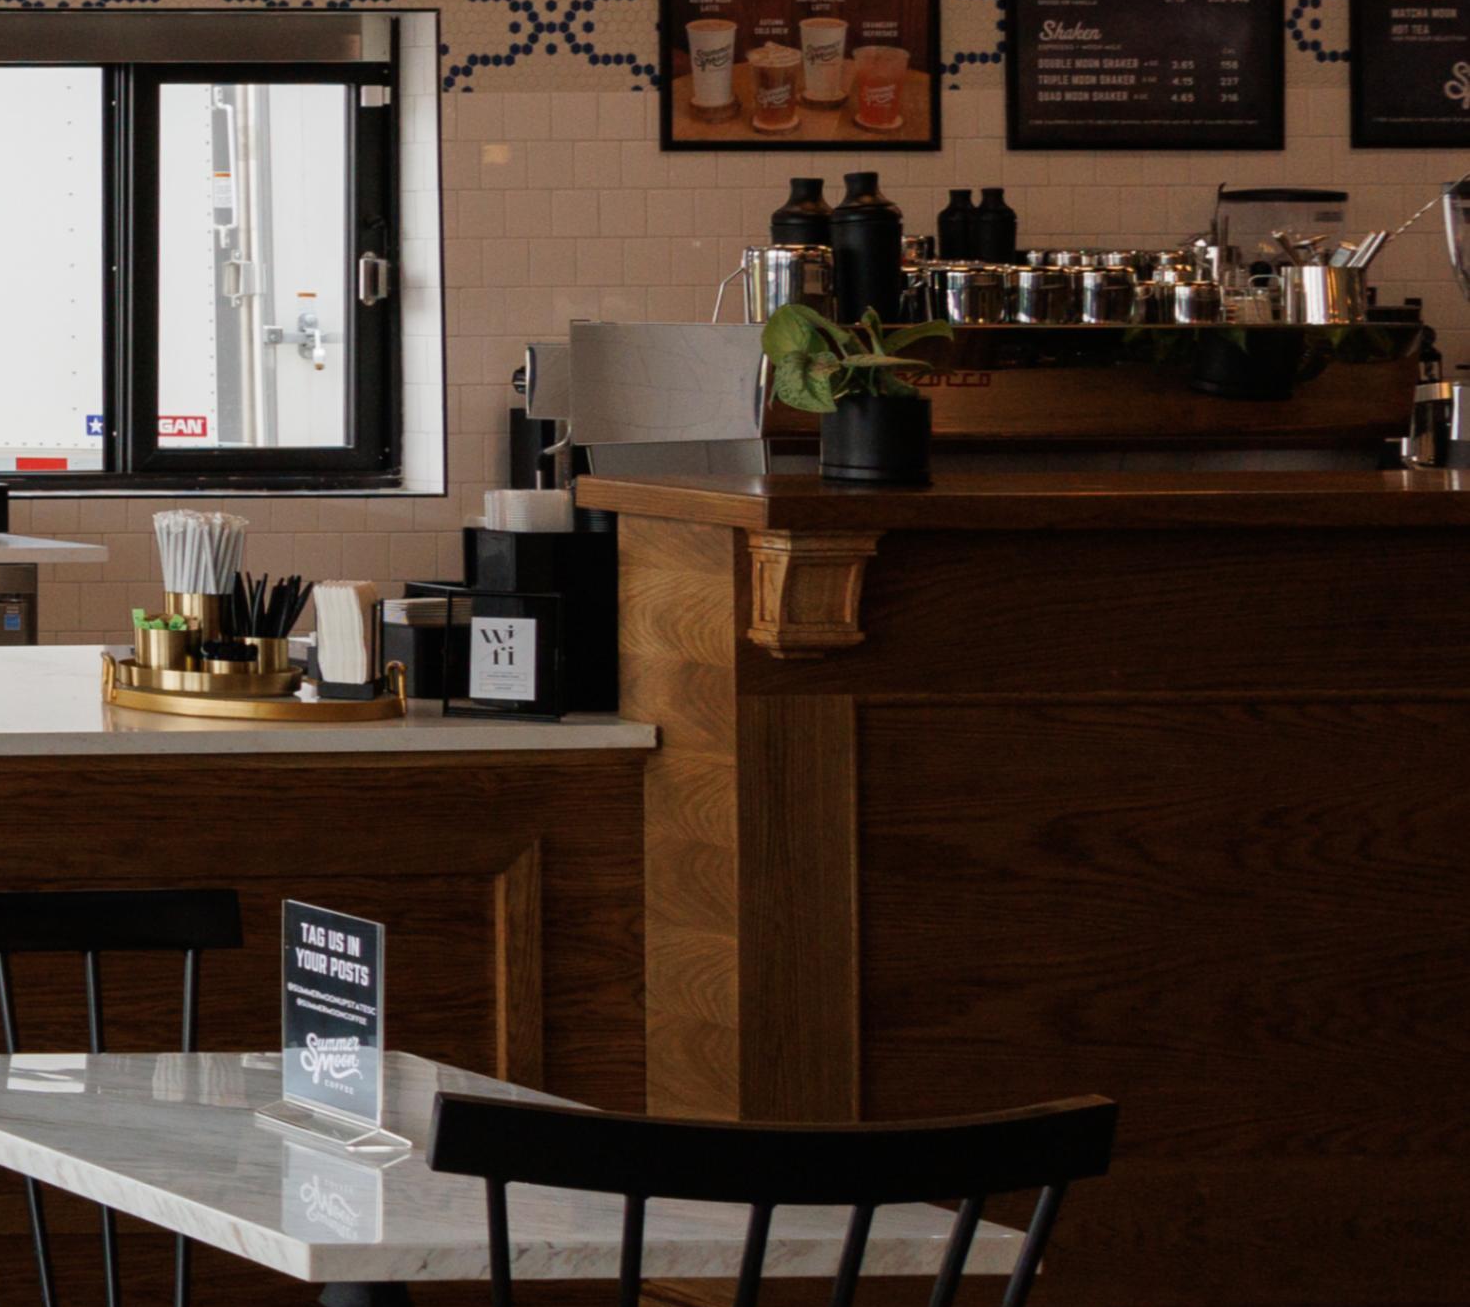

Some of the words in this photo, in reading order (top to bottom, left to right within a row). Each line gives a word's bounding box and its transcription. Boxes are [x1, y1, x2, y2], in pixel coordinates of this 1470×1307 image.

[1038, 19, 1102, 41] Shaken
[300, 922, 326, 948] TAG
[327, 929, 345, 953] US
[347, 935, 360, 958] IN
[295, 947, 327, 975] YOUR
[330, 957, 369, 986] POSTS
